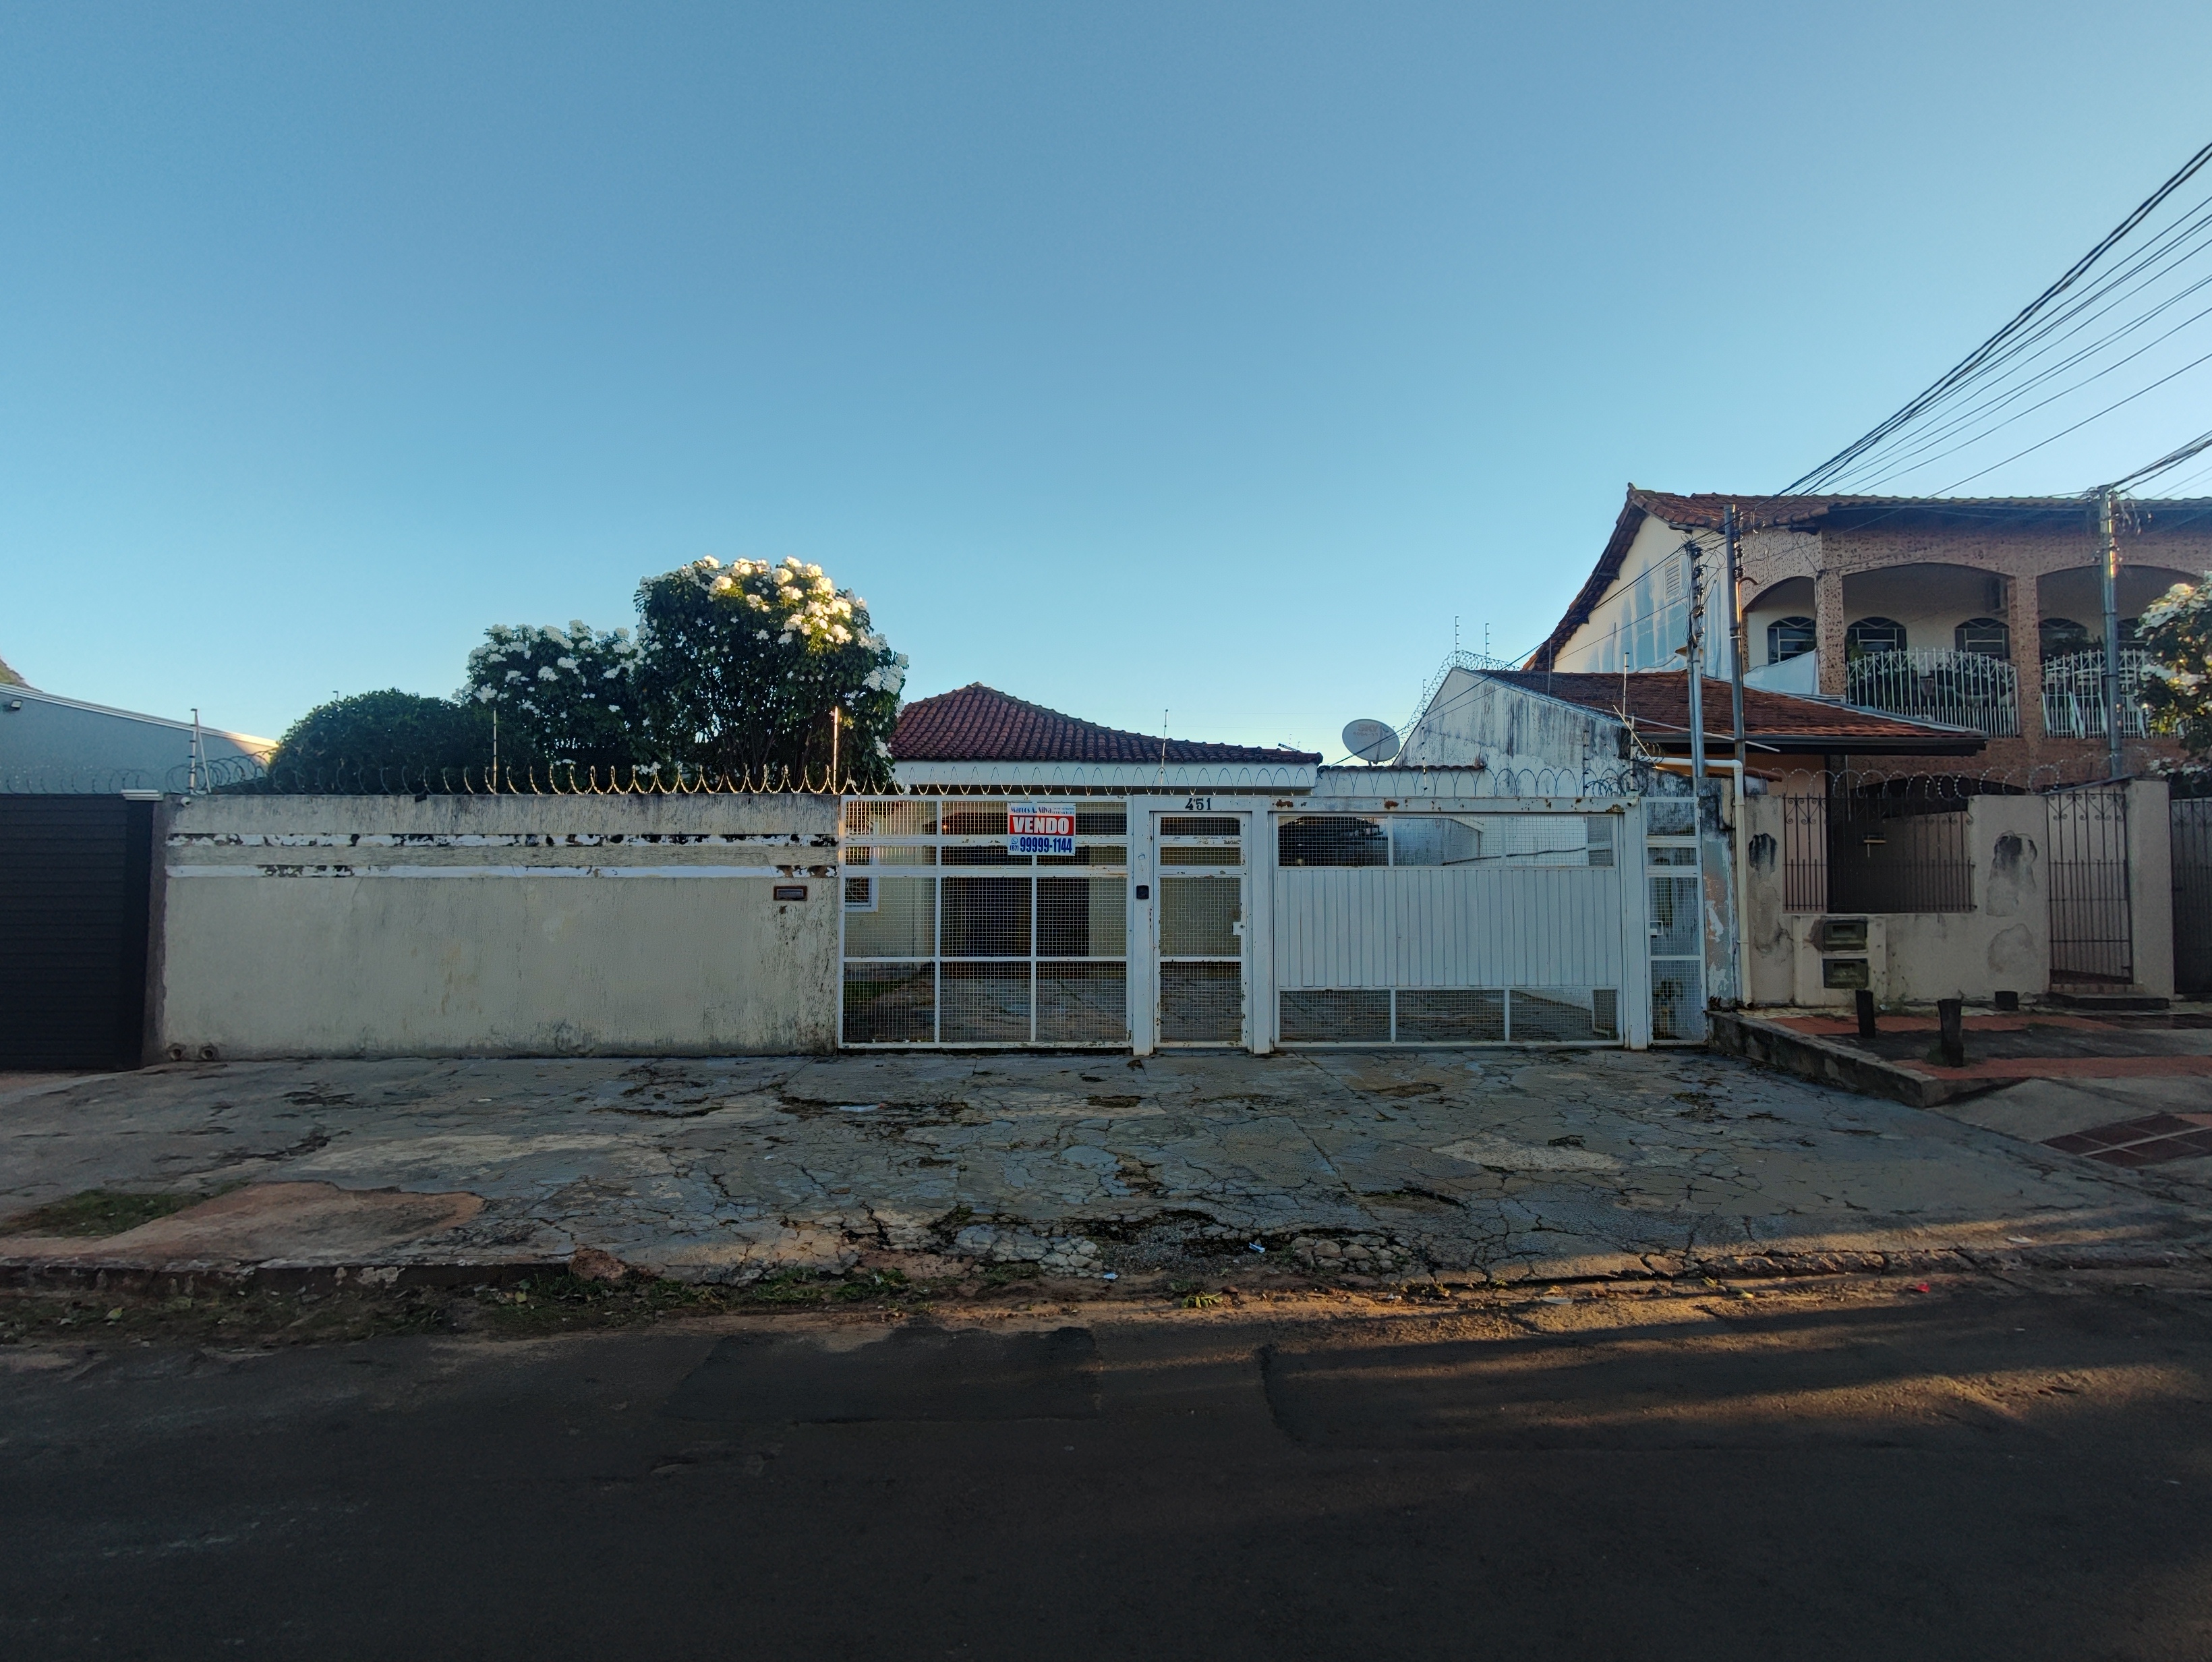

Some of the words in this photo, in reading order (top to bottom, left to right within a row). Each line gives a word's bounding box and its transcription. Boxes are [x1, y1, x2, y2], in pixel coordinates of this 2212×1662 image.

[1358, 724, 1380, 732] SKY
[1185, 797, 1211, 810] 451
[1012, 816, 1070, 834] VENDO
[1020, 837, 1072, 853] 99999-1144
